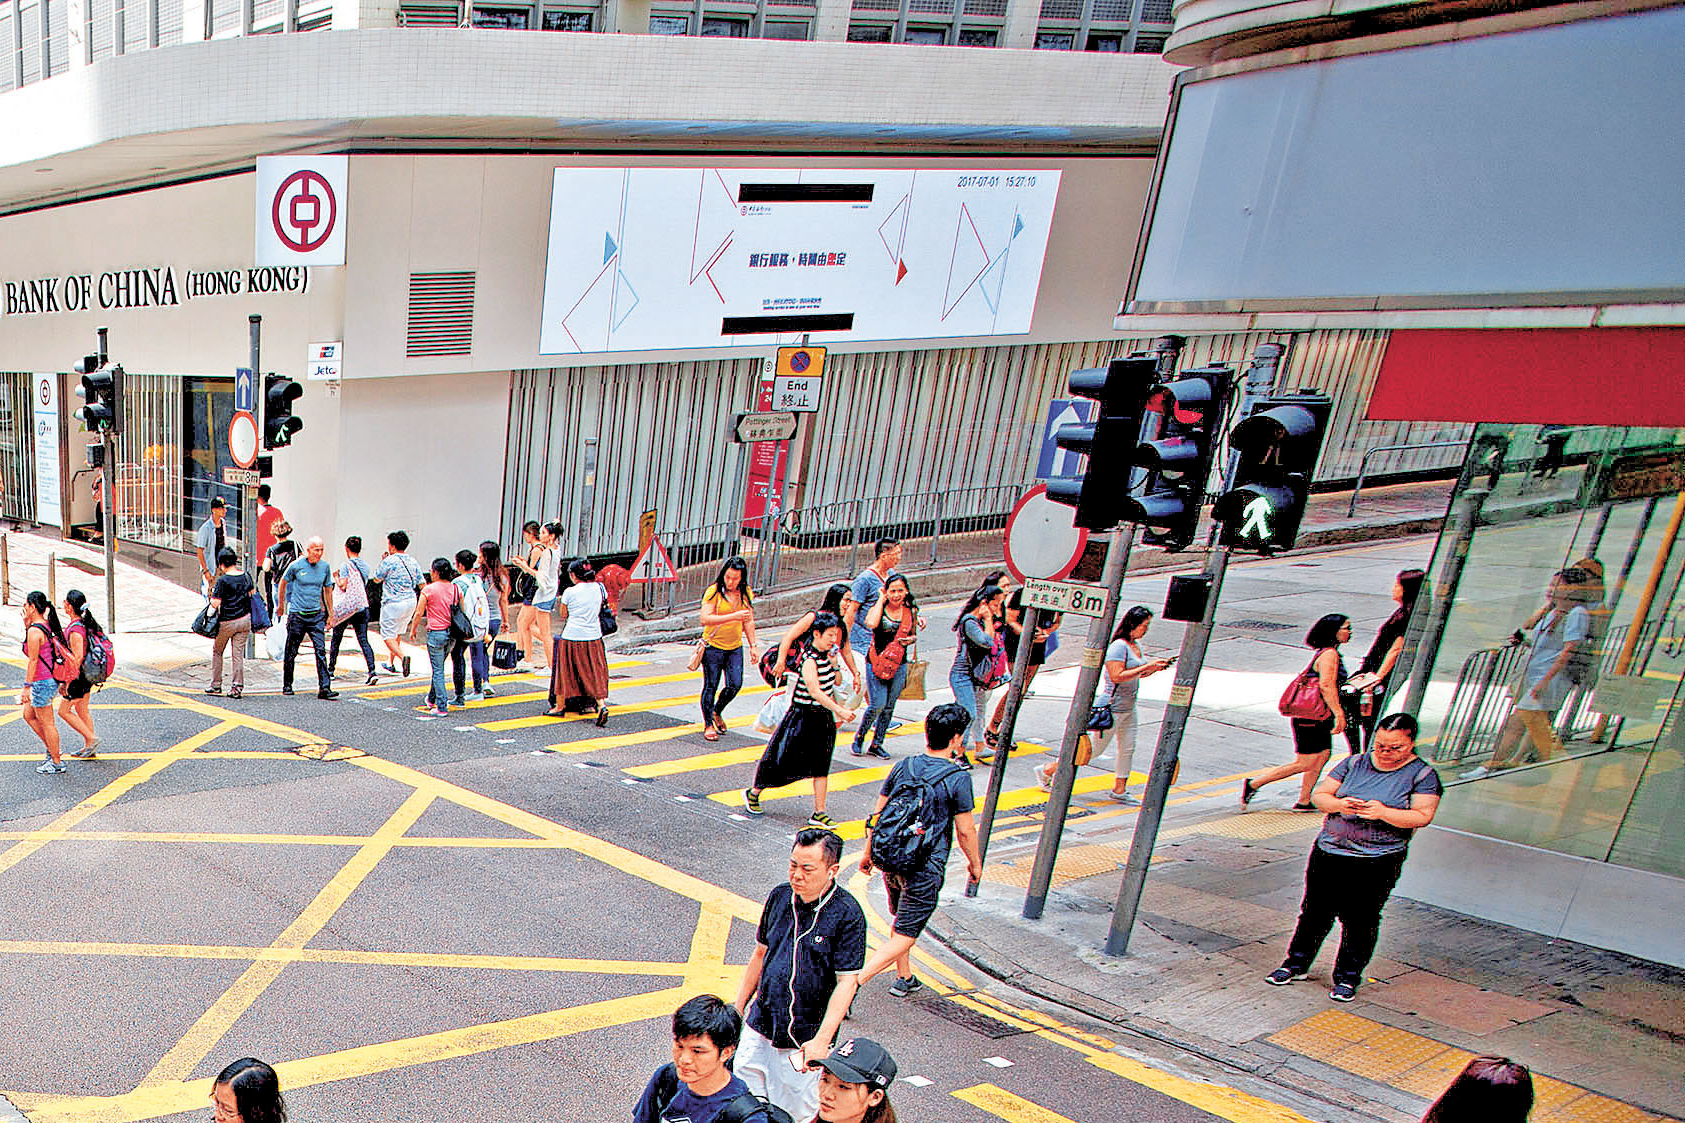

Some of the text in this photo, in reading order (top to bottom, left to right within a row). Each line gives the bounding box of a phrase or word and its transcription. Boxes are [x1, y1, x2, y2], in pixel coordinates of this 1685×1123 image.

[957, 176, 999, 187] 2017-07-01
[6, 266, 308, 313] BANK OF CHINA (HONG KONG)
[787, 380, 809, 391] End
[780, 393, 809, 407] 終止
[772, 415, 791, 425] Street
[1026, 581, 1068, 595] Length over
[1071, 590, 1102, 612] 8m
